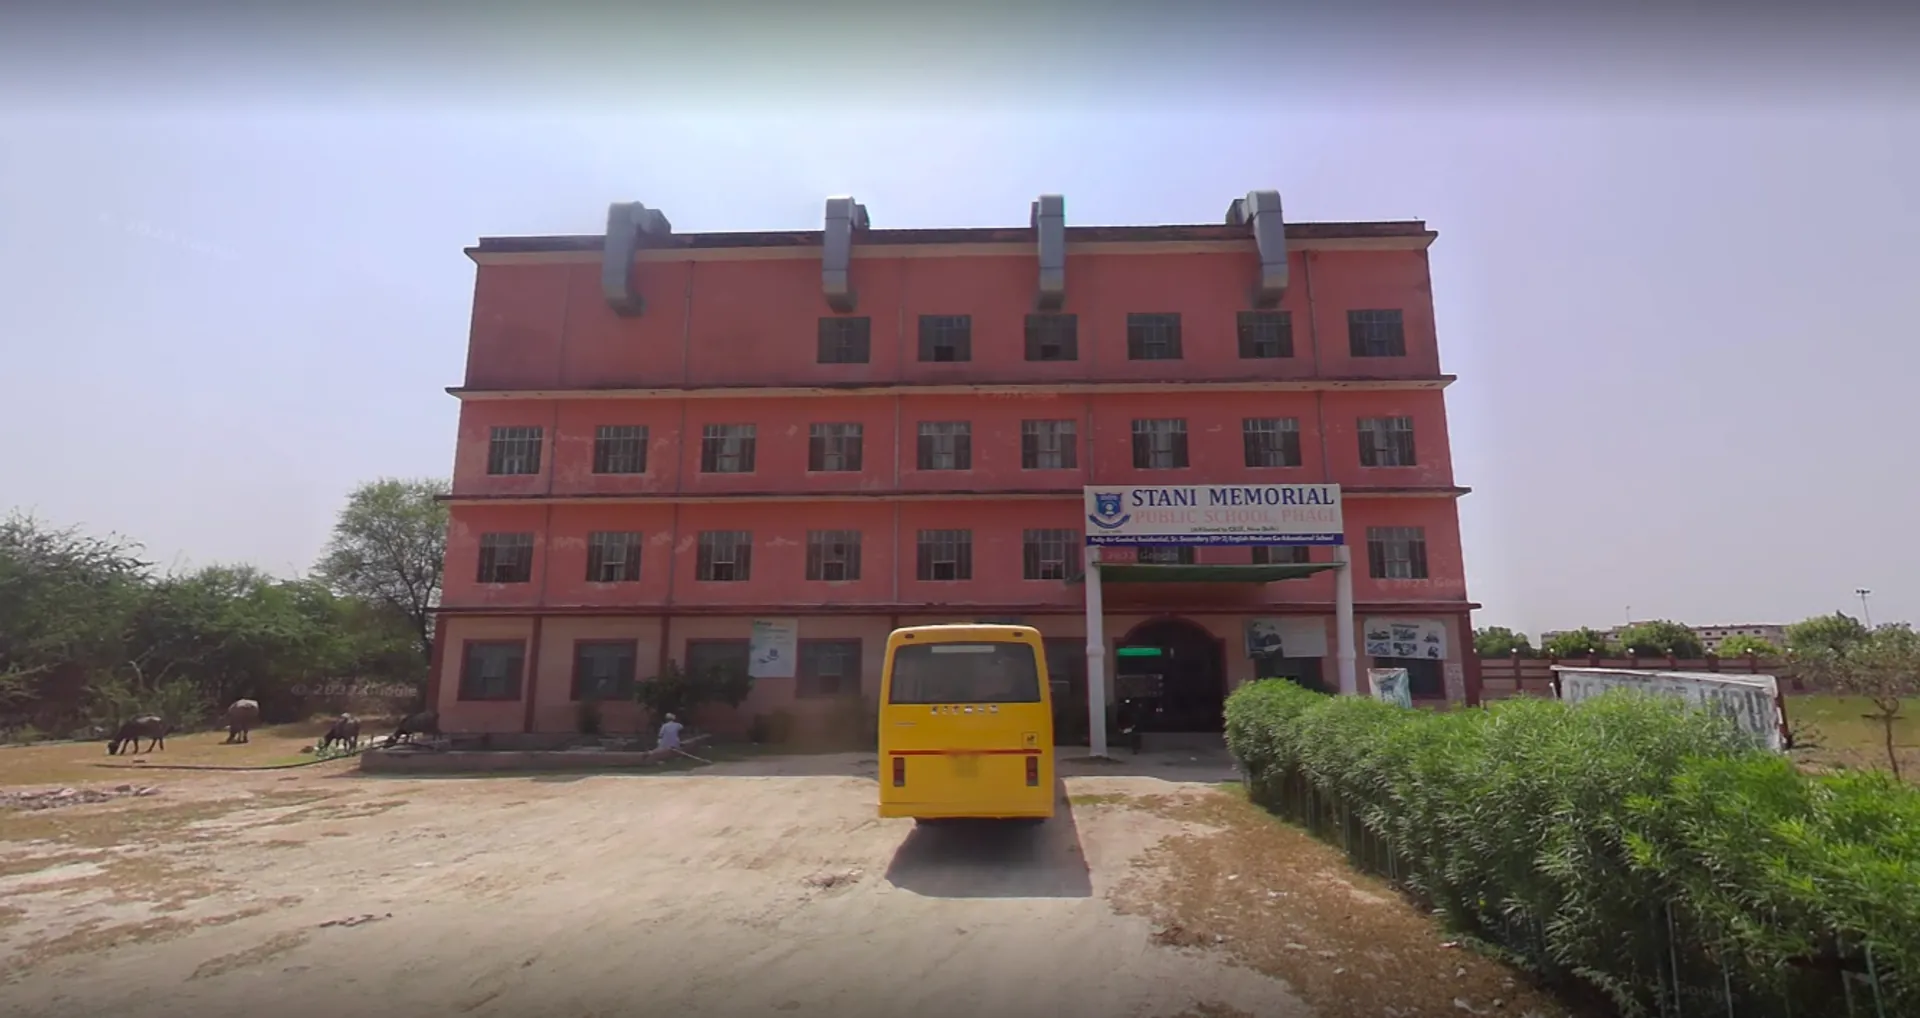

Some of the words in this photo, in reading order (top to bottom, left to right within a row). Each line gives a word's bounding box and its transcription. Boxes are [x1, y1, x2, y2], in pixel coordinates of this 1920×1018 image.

[1132, 489, 1197, 507] STANI
[1210, 487, 1335, 507] MEMORIAL
[1135, 509, 1197, 524] PUBLIC
[1204, 508, 1277, 524] SCHOOL,
[1282, 507, 1335, 523] PHAGI
